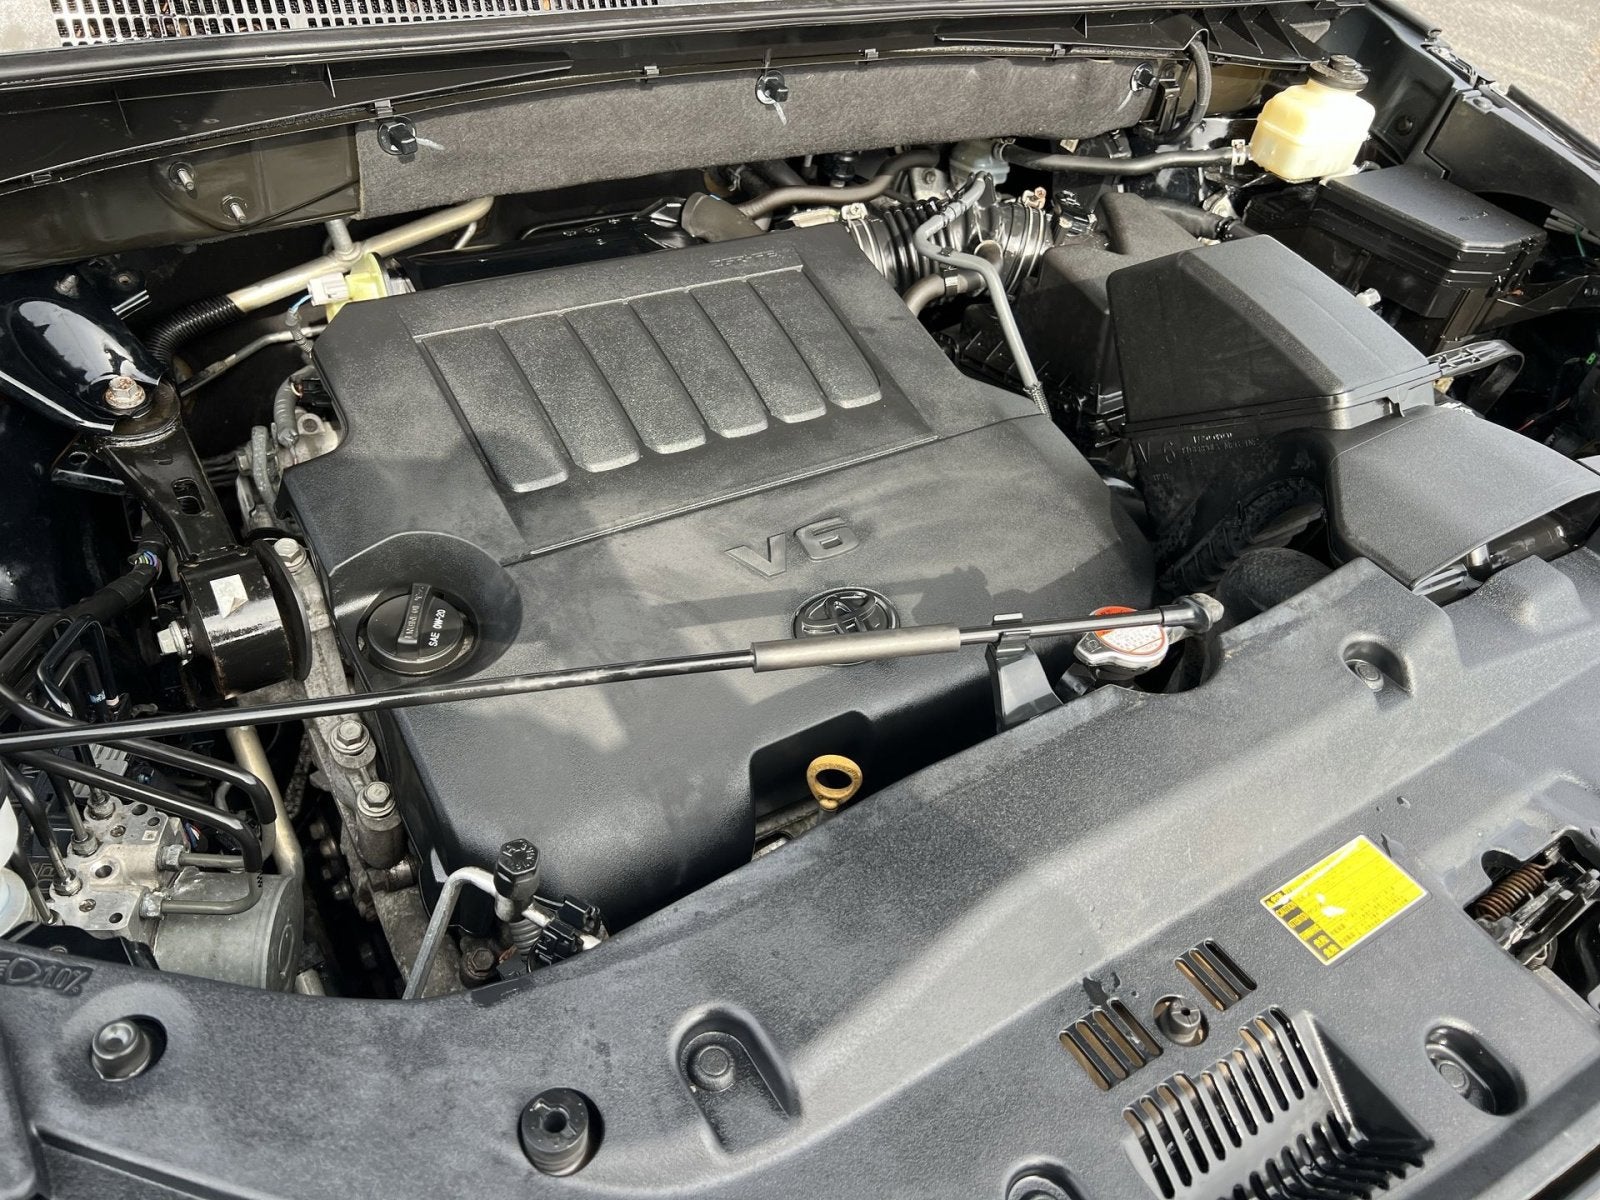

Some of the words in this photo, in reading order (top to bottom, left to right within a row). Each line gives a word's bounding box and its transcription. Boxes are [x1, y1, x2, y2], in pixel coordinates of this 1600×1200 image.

[723, 515, 861, 578] V6
[432, 608, 446, 629] 0W-20
[428, 631, 441, 647] SAE
